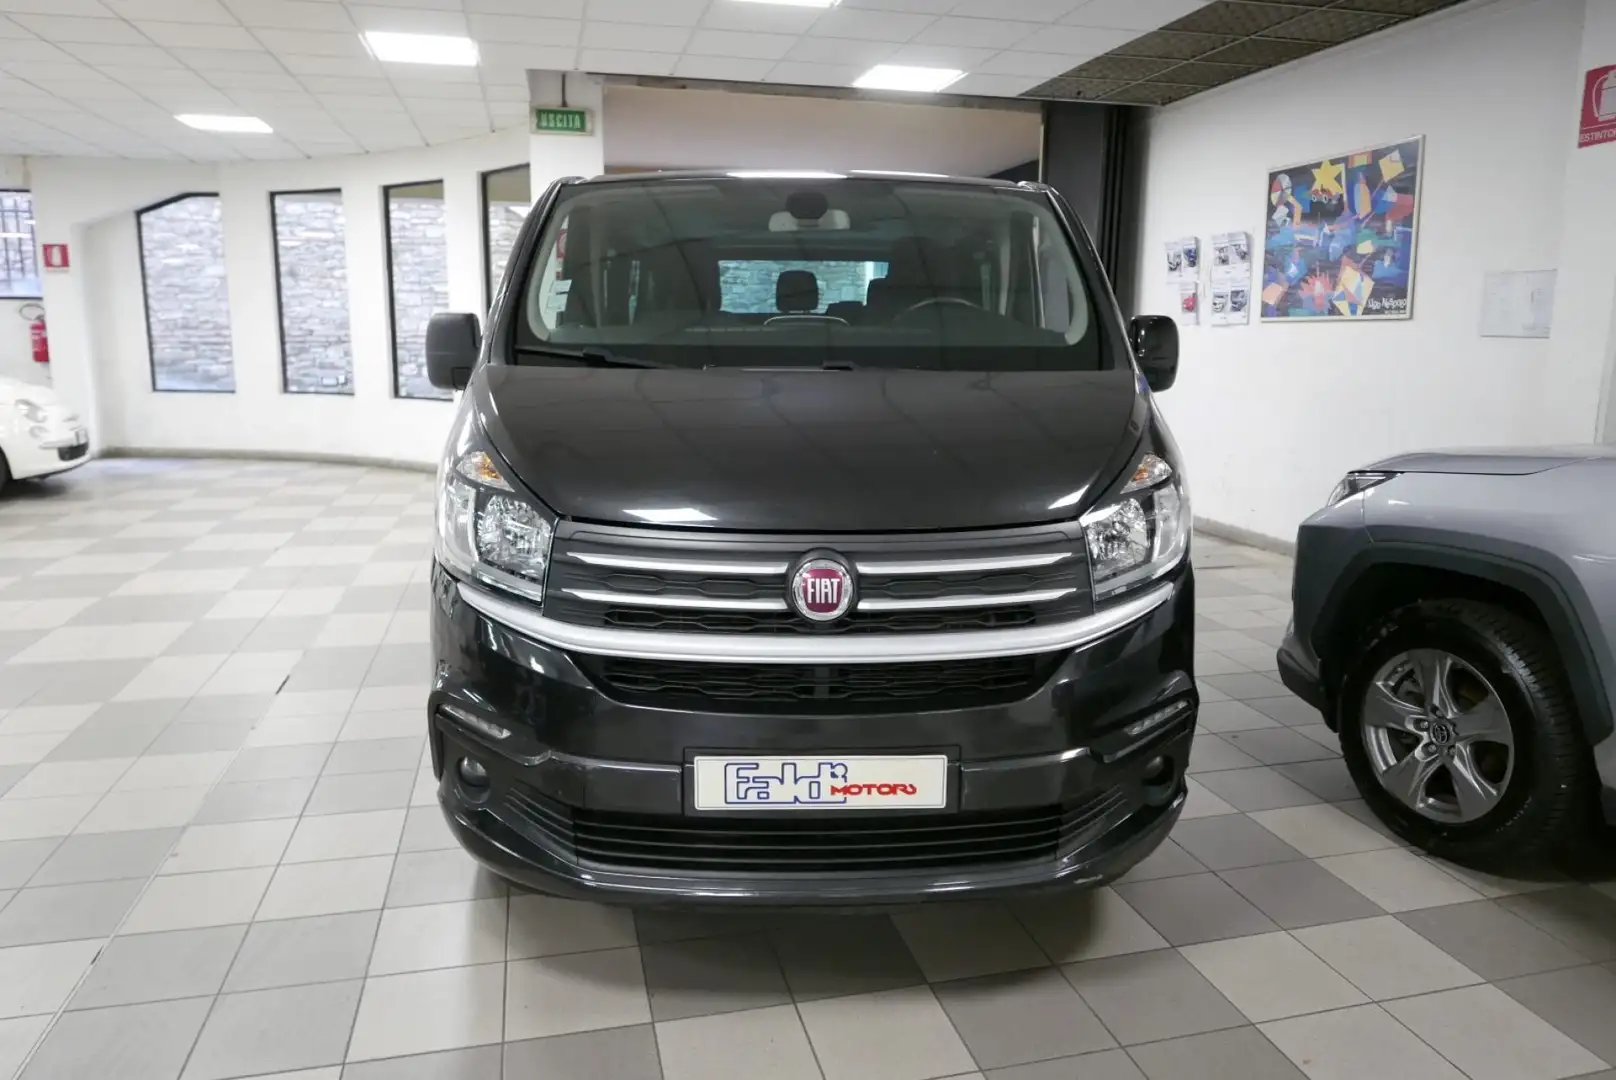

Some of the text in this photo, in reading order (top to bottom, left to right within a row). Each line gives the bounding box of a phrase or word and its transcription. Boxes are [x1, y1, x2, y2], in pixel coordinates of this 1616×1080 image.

[540, 112, 581, 129] USCITA
[807, 578, 840, 604] FIAT
[831, 783, 917, 796] MOTORS
